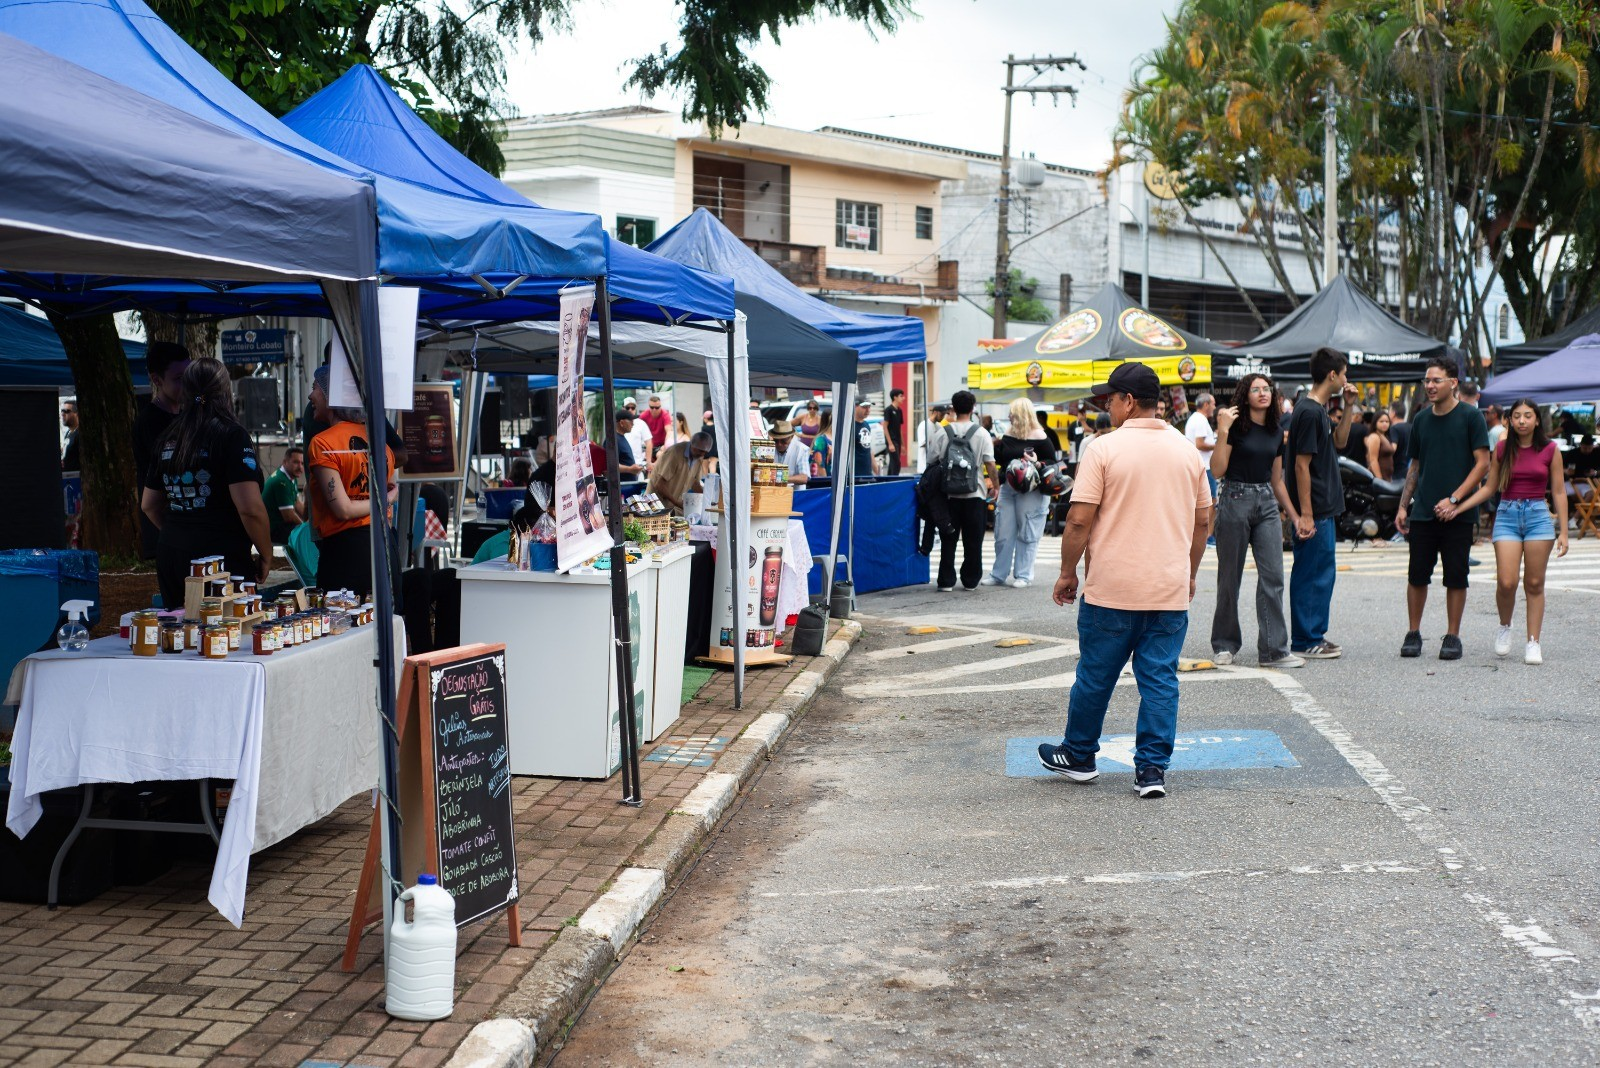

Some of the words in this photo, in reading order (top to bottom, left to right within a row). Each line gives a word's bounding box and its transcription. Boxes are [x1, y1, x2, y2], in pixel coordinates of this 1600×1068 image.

[222, 342, 255, 351] Monteiro
[257, 341, 282, 349] Lobato
[1228, 364, 1272, 378] ARKANGEL
[441, 664, 489, 696] DEGUSTAÇÃO
[488, 744, 505, 766] TUDO
[442, 840, 472, 860] TOMATE
[443, 859, 479, 881] GOIABADA
[481, 842, 503, 866] CASCÃO
[468, 879, 478, 893] DE
